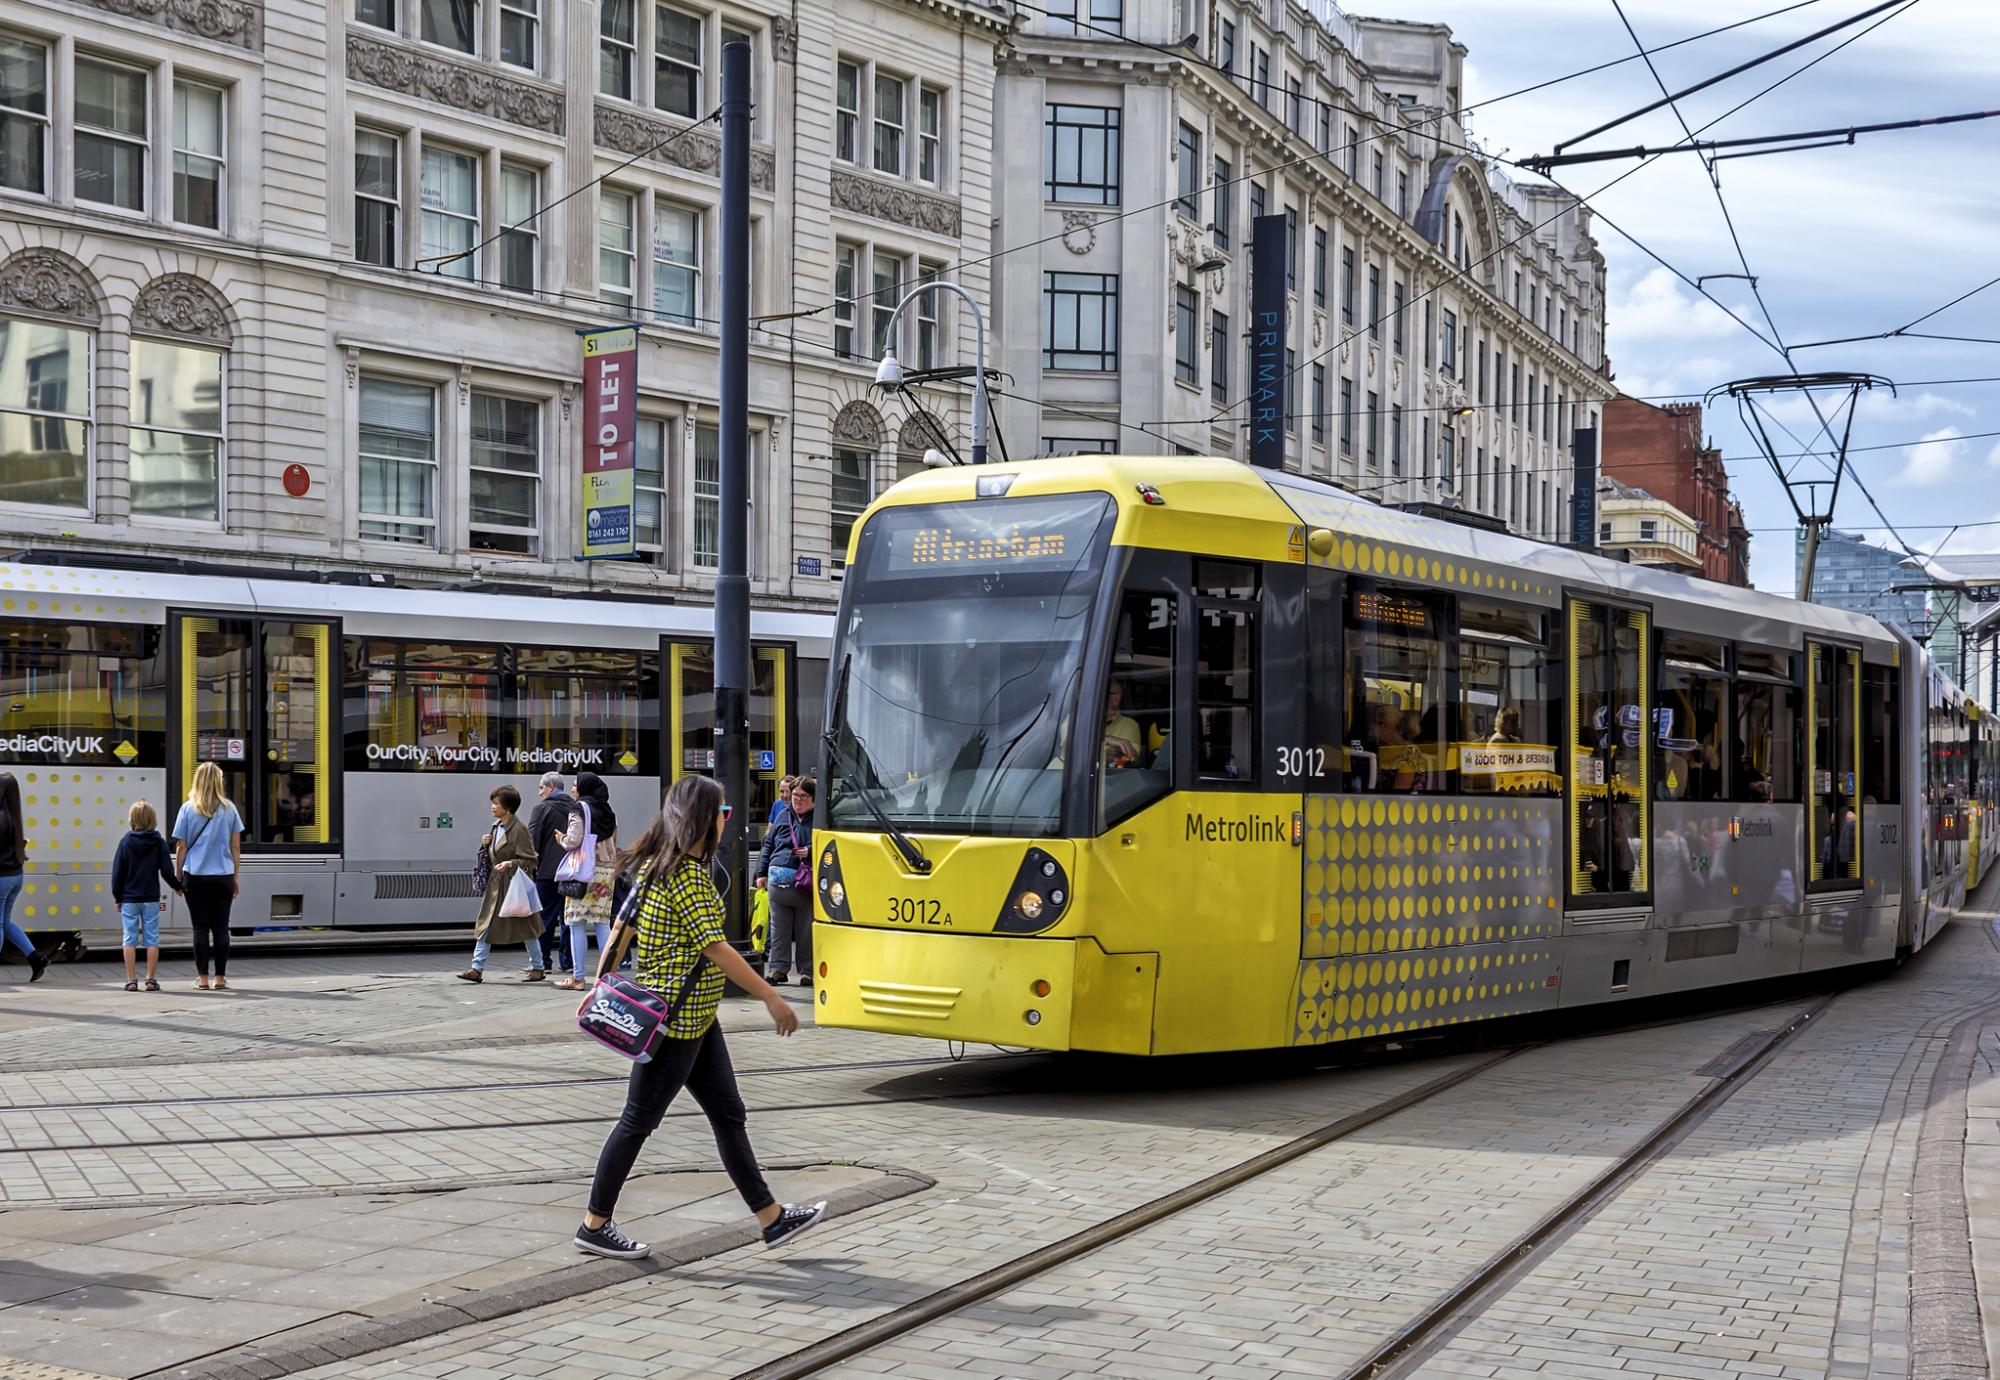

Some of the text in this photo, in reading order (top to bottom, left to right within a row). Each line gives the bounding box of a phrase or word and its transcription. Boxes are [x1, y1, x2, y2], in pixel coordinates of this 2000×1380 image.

[600, 360, 620, 413] LET
[1257, 311, 1278, 444] PRIMARK
[599, 423, 618, 467] TO
[366, 743, 431, 766] OurCity.
[434, 745, 502, 769] YourCity.
[506, 747, 603, 768] MediaCityUK
[1276, 747, 1325, 777] 3012
[1185, 813, 1286, 842] Metrolink
